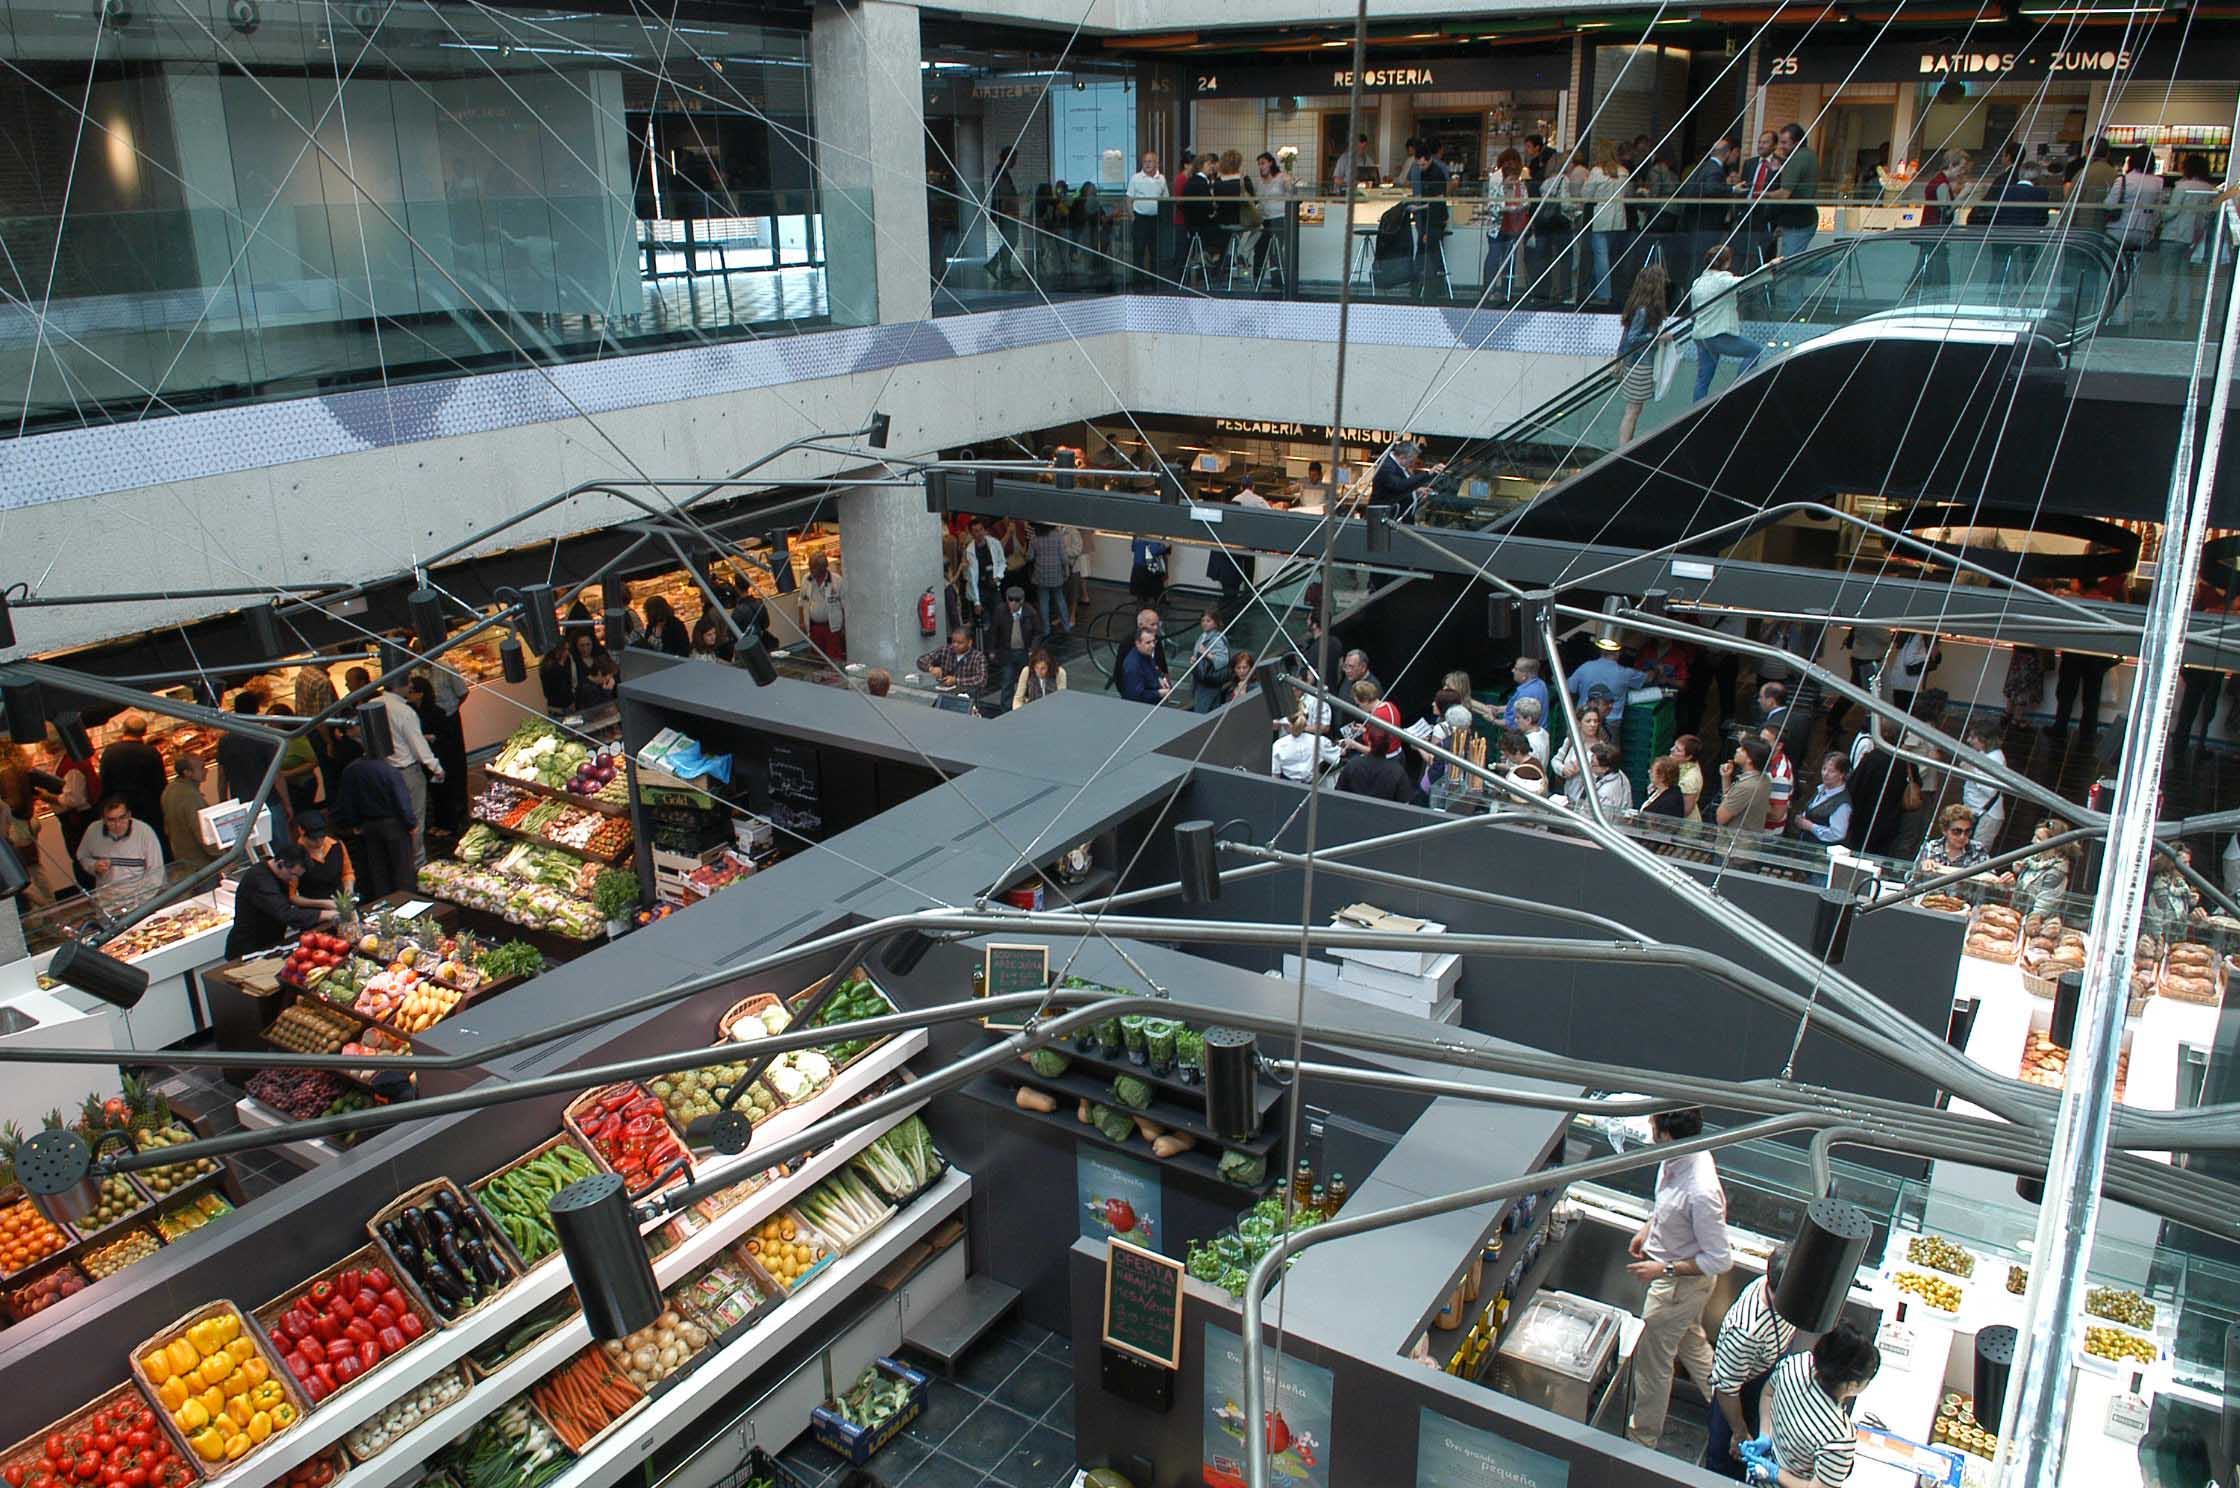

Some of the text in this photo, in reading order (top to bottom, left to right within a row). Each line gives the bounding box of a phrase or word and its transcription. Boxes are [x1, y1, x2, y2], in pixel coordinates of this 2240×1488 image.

[1771, 57, 1798, 75] 25
[1920, 51, 2131, 73] BATIDOS ZUMOS
[1198, 76, 1217, 92] 24
[1334, 68, 1433, 87] REOSTERIA
[1216, 419, 1303, 436] PESCADERIA
